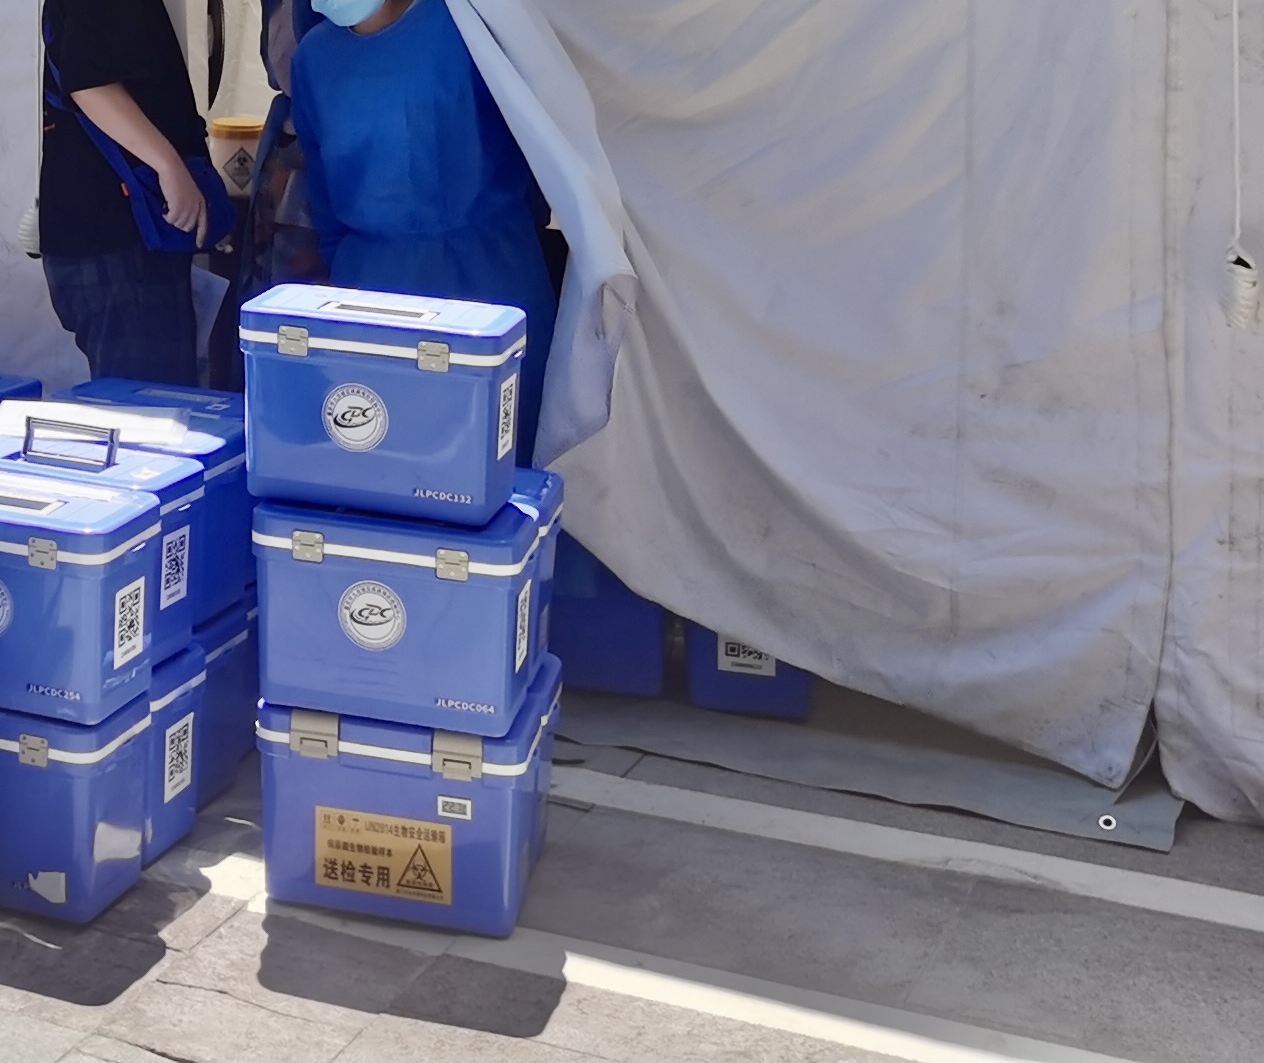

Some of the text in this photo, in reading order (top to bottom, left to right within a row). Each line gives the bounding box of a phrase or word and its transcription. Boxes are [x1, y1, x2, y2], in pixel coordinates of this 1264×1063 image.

[414, 487, 472, 505] JLPCDC132
[435, 696, 496, 715] JLPCDC064
[322, 857, 391, 889] 送检专用
